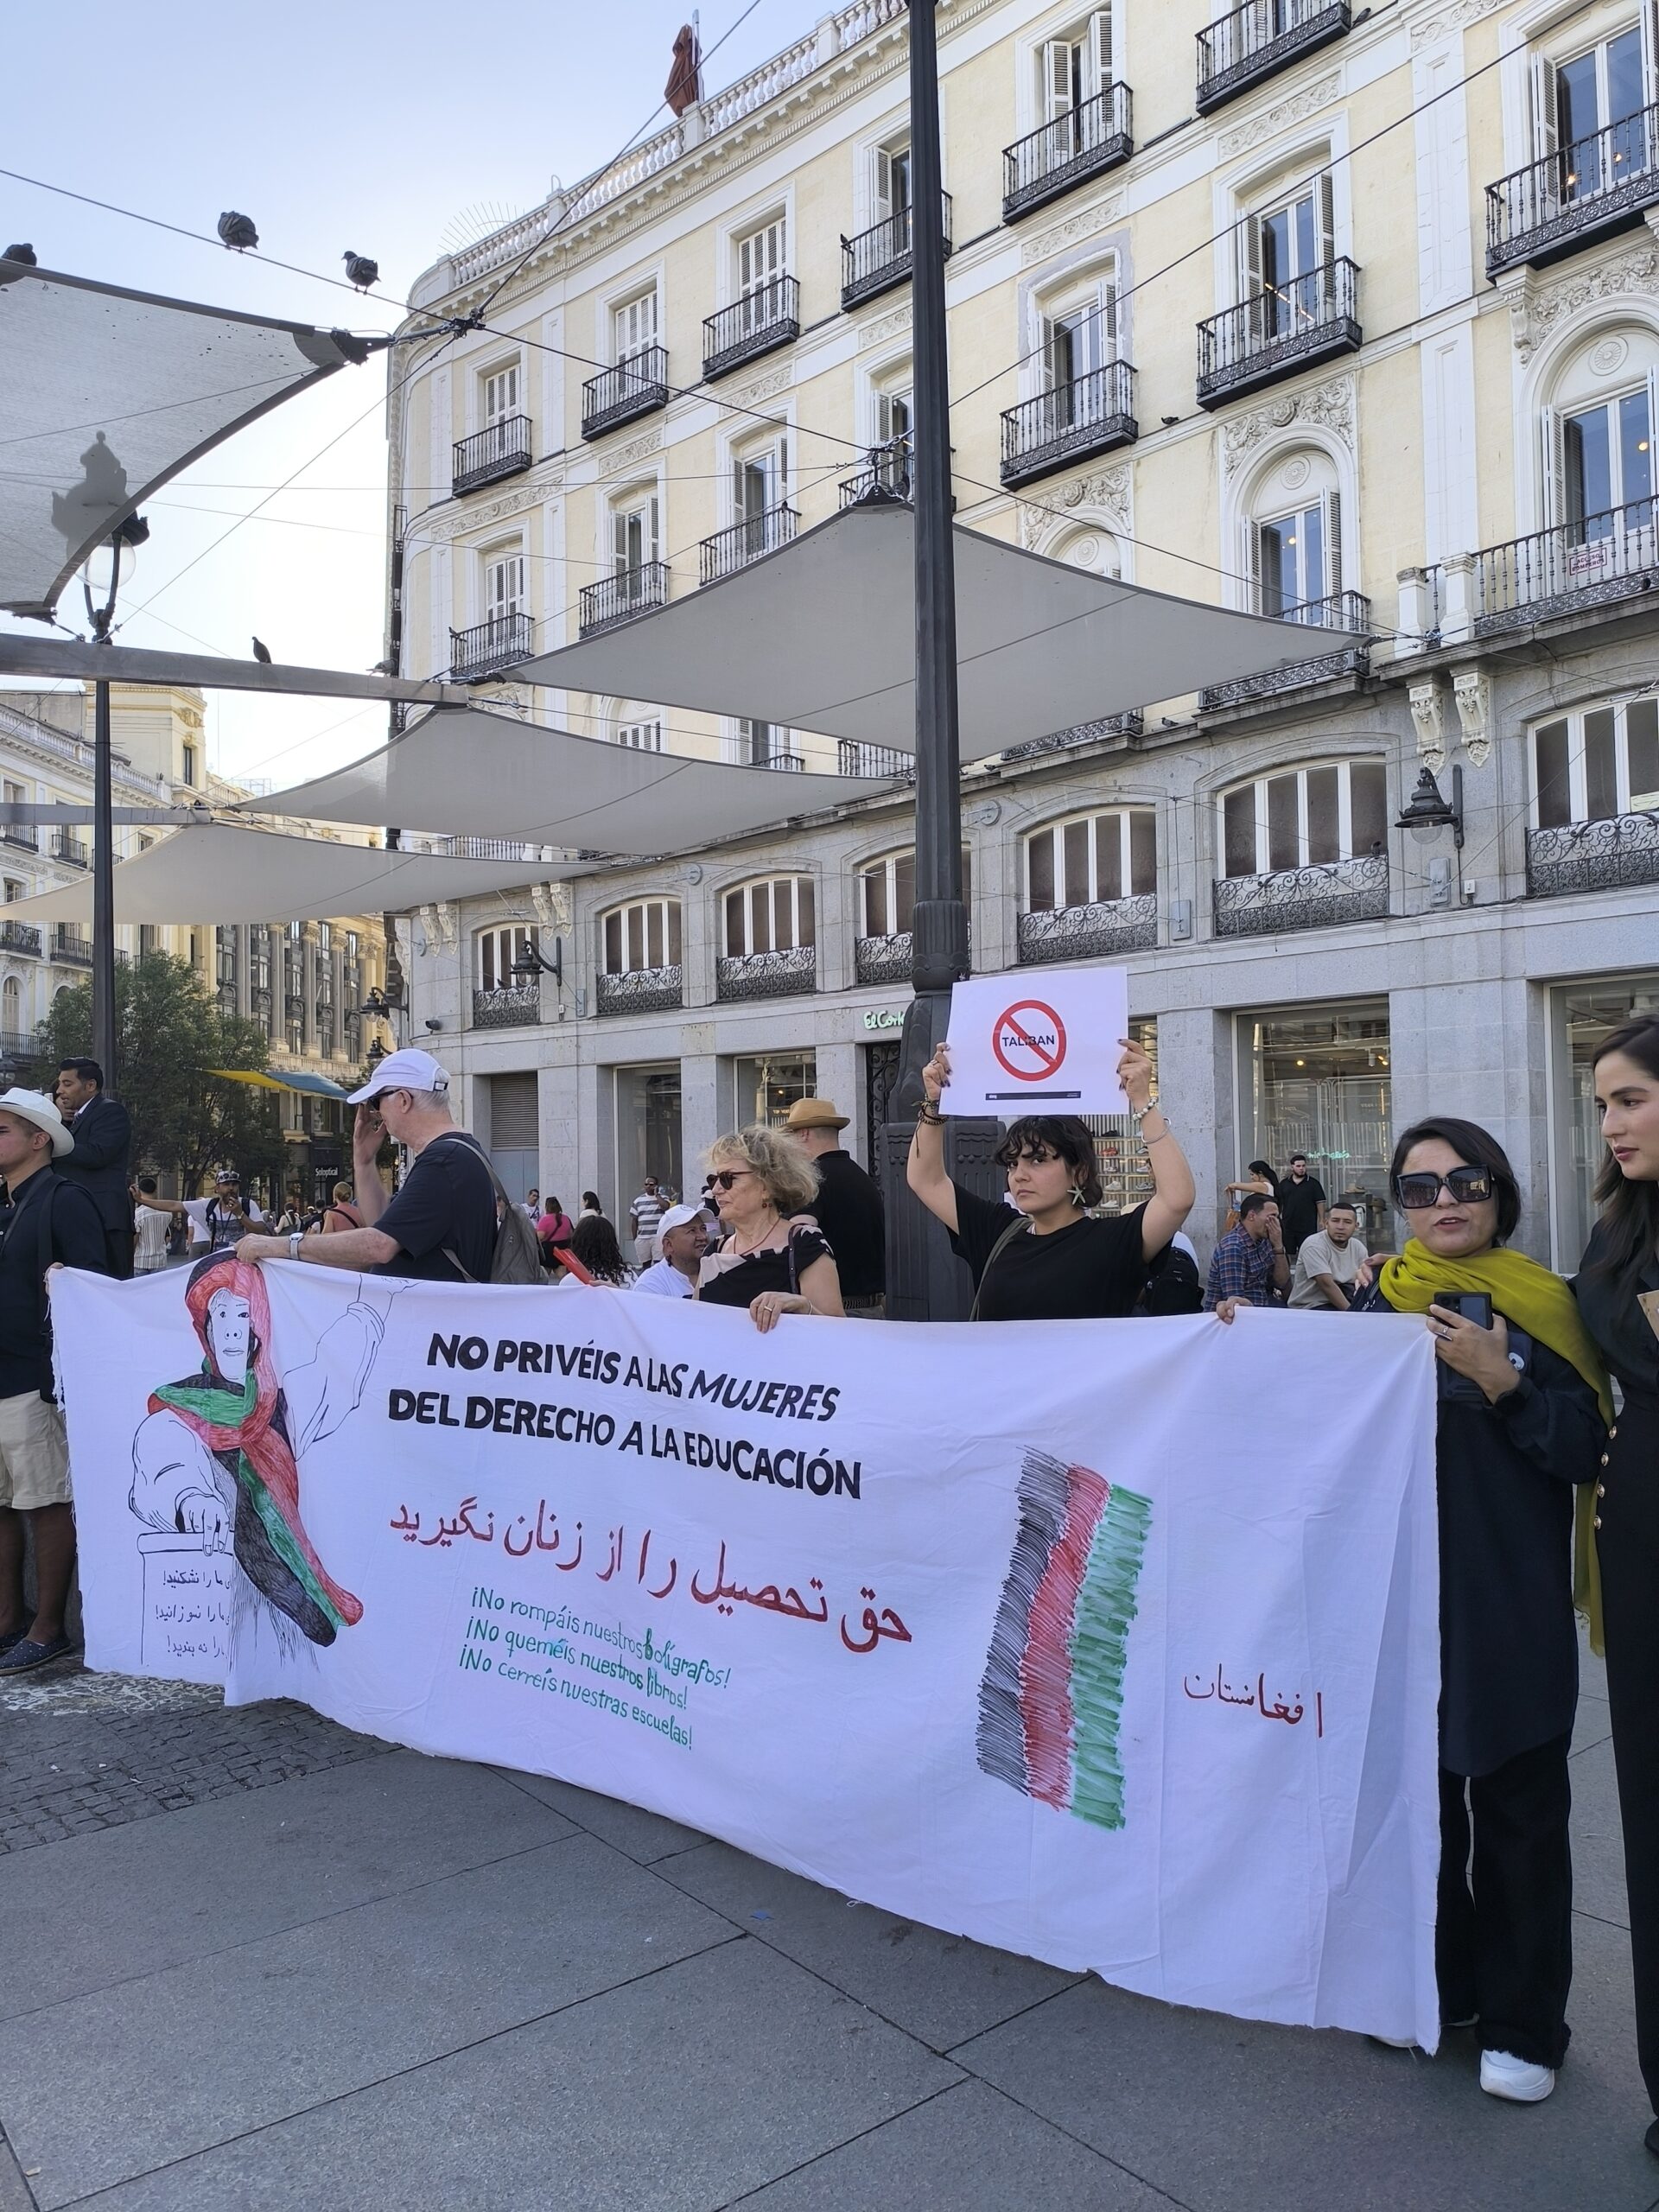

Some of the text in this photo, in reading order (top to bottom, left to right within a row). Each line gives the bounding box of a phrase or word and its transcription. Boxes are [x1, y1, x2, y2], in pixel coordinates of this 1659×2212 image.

[864, 1011, 878, 1029] El
[1002, 1035, 1055, 1047] TALIBAN
[427, 1333, 841, 1421] NO PRIVÉIS A LAS MUJERES
[389, 1389, 861, 1499] DEL DERECHO A LA EDUCACIÓN
[203, 1571, 212, 1588] را
[390, 1496, 912, 1653] حق تحصیل را از زنان نگیرید
[466, 1616, 688, 1710] ¡No queméis nuestros libros!
[472, 1586, 731, 1688] ¡No rompáis nuestros bolígrafos!
[459, 1643, 493, 1672] ¡No
[560, 1679, 629, 1718] nuestras
[632, 1707, 692, 1751] escuelas!
